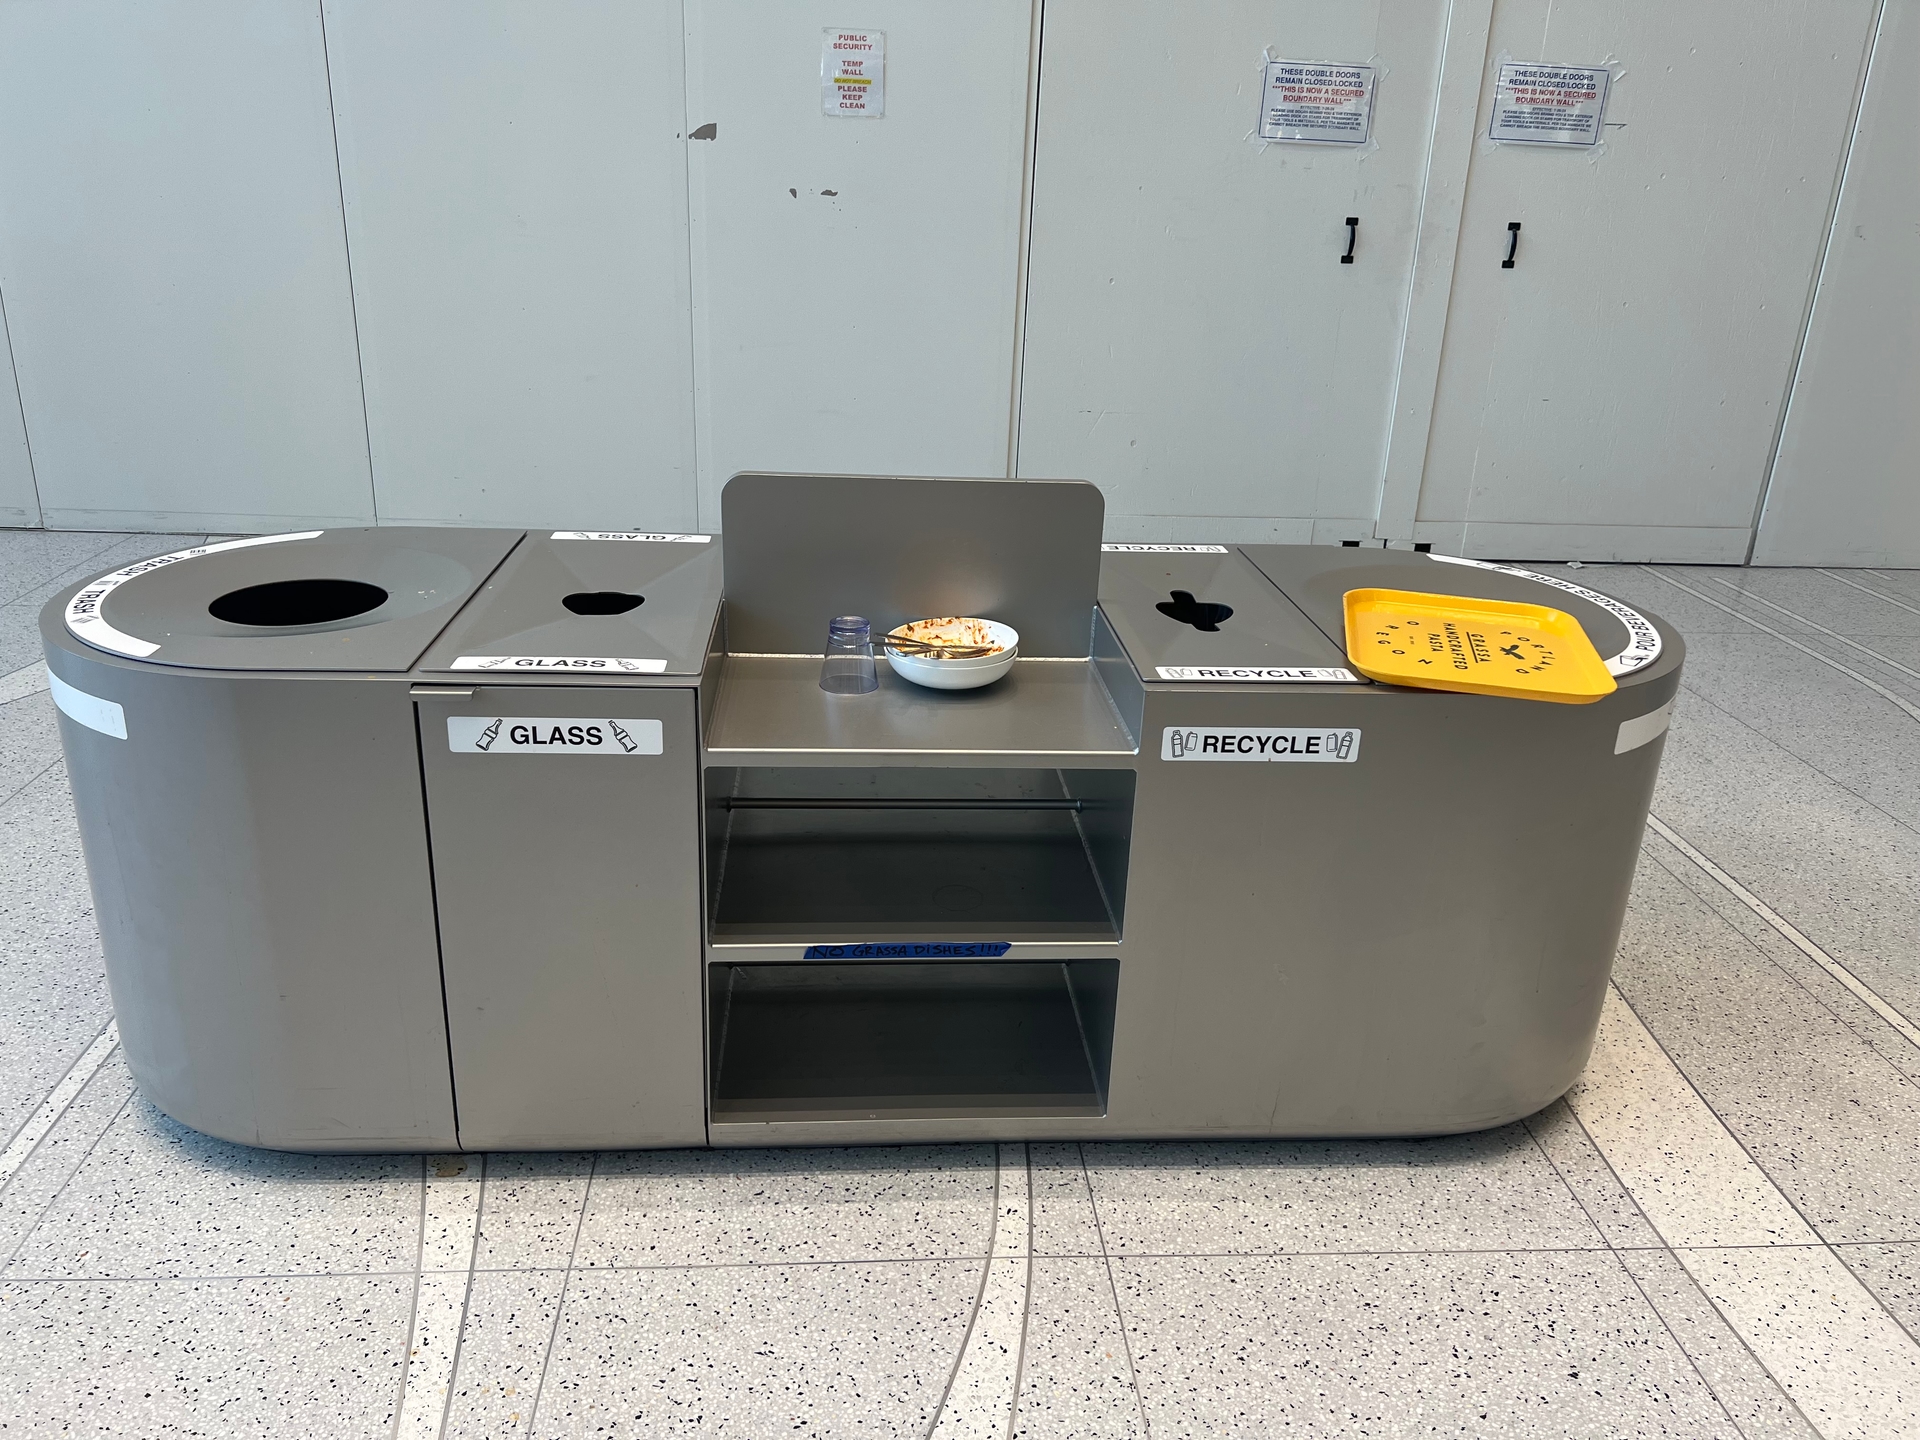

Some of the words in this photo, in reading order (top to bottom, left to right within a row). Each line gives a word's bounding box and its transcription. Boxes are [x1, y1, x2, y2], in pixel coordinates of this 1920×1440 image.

[1336, 71, 1360, 79] DOORS
[1283, 95, 1322, 103] BOUNDARY
[116, 556, 184, 576] TRASH
[1524, 573, 1575, 590] HERE
[73, 590, 106, 614] TRASH
[1574, 590, 1650, 630] BEVERAGES
[1428, 633, 1444, 652] PASTA
[1443, 622, 1468, 670] HANDCRAFTED
[1471, 634, 1492, 662] GRASSA
[515, 659, 606, 668] GLASS
[1198, 670, 1318, 678] RECYCLE
[510, 726, 603, 745] GLASS
[1202, 735, 1321, 754] RECYCLE
[812, 946, 844, 957] NO
[852, 945, 907, 957] GRASSA
